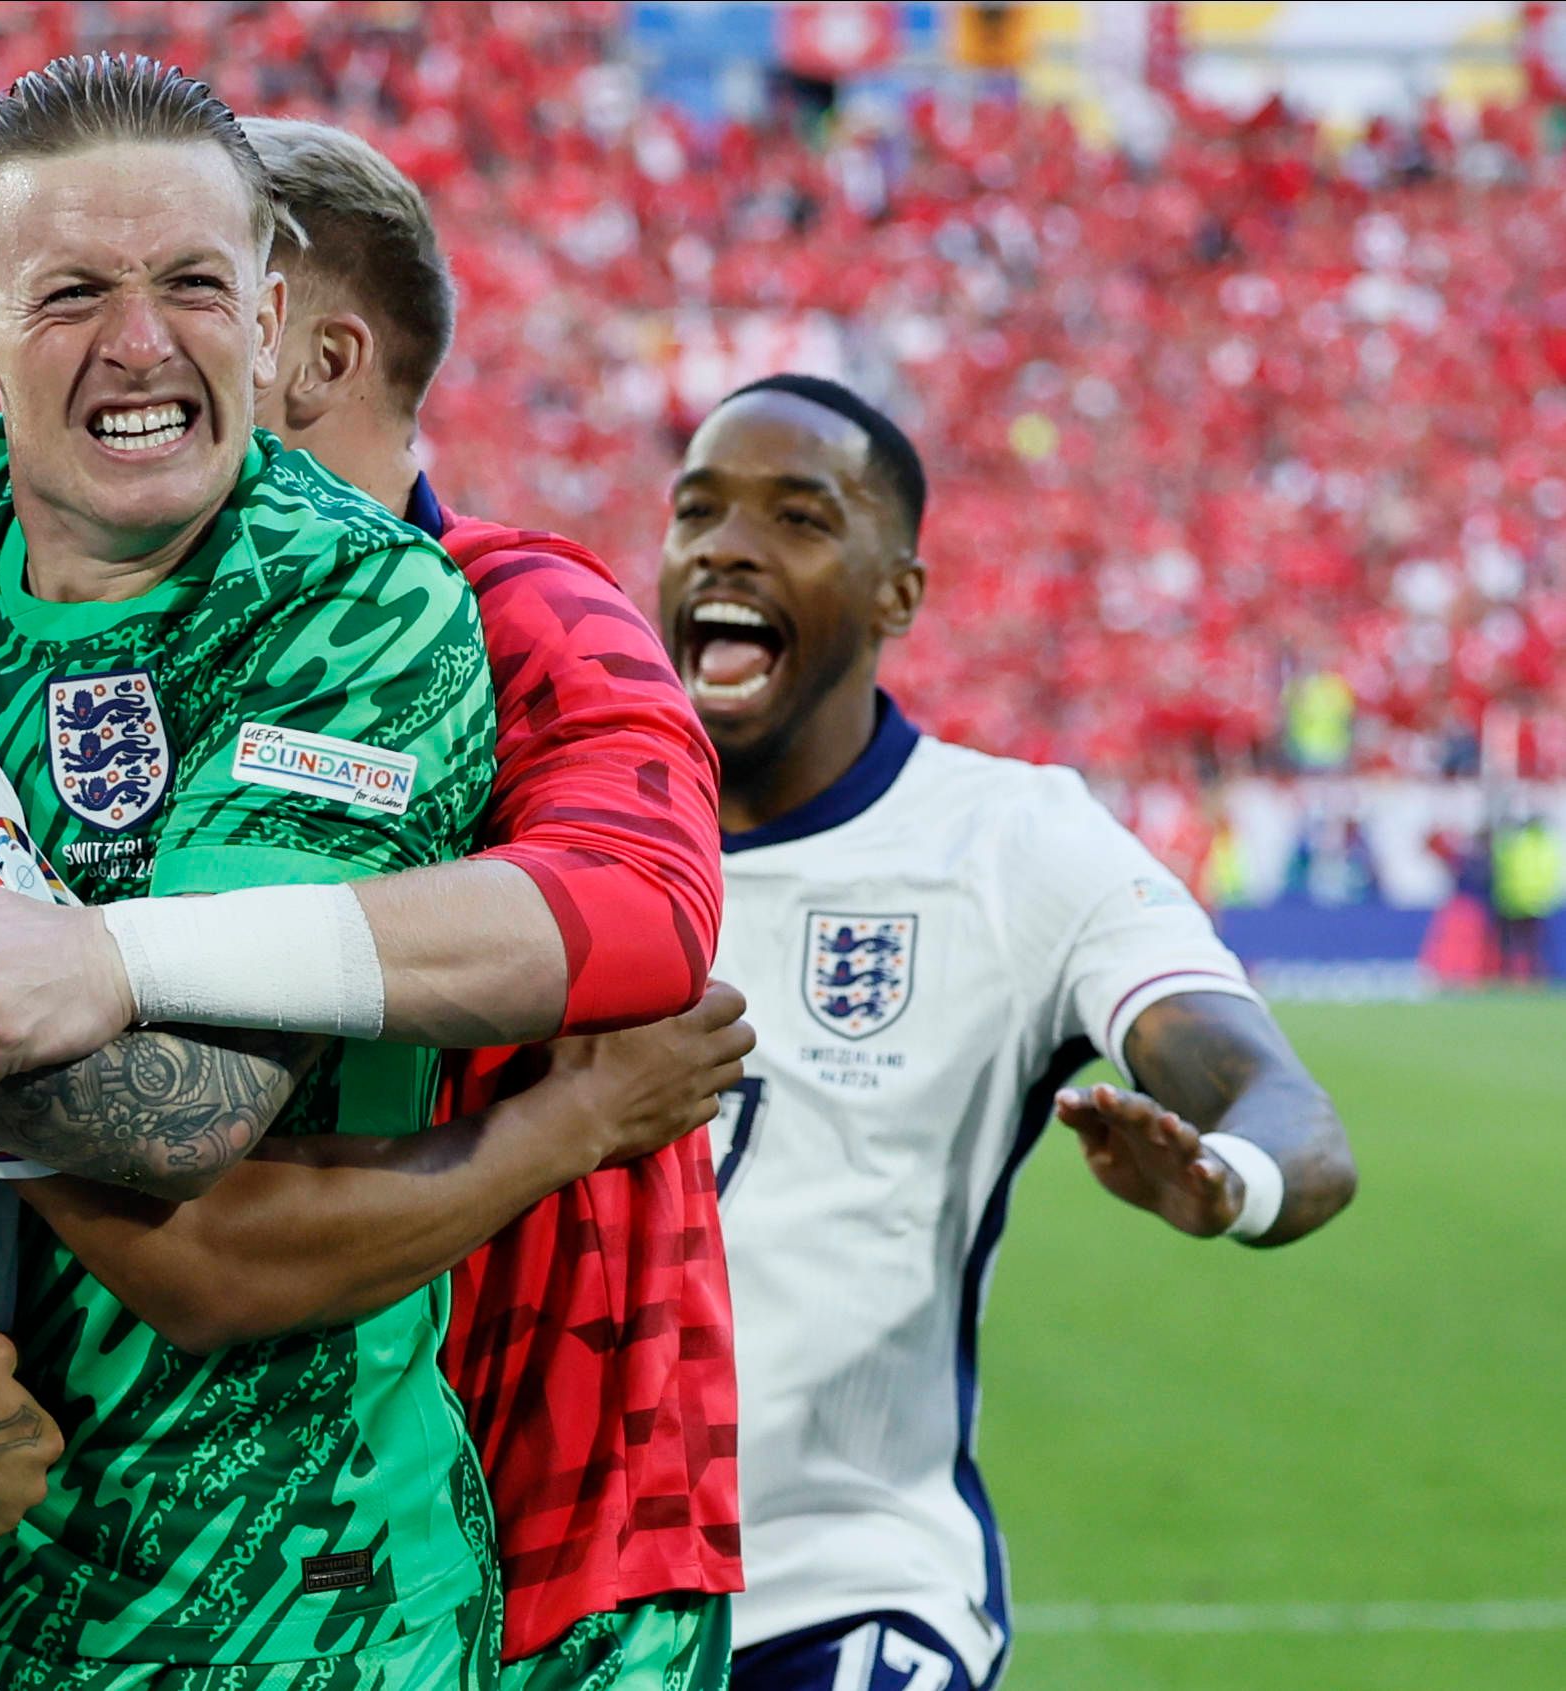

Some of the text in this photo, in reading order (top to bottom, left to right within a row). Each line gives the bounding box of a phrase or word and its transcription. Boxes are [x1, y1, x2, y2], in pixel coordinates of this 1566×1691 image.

[243, 727, 286, 743] UEFA
[240, 742, 410, 793] FOUNDATION
[831, 1620, 954, 1691] 17
